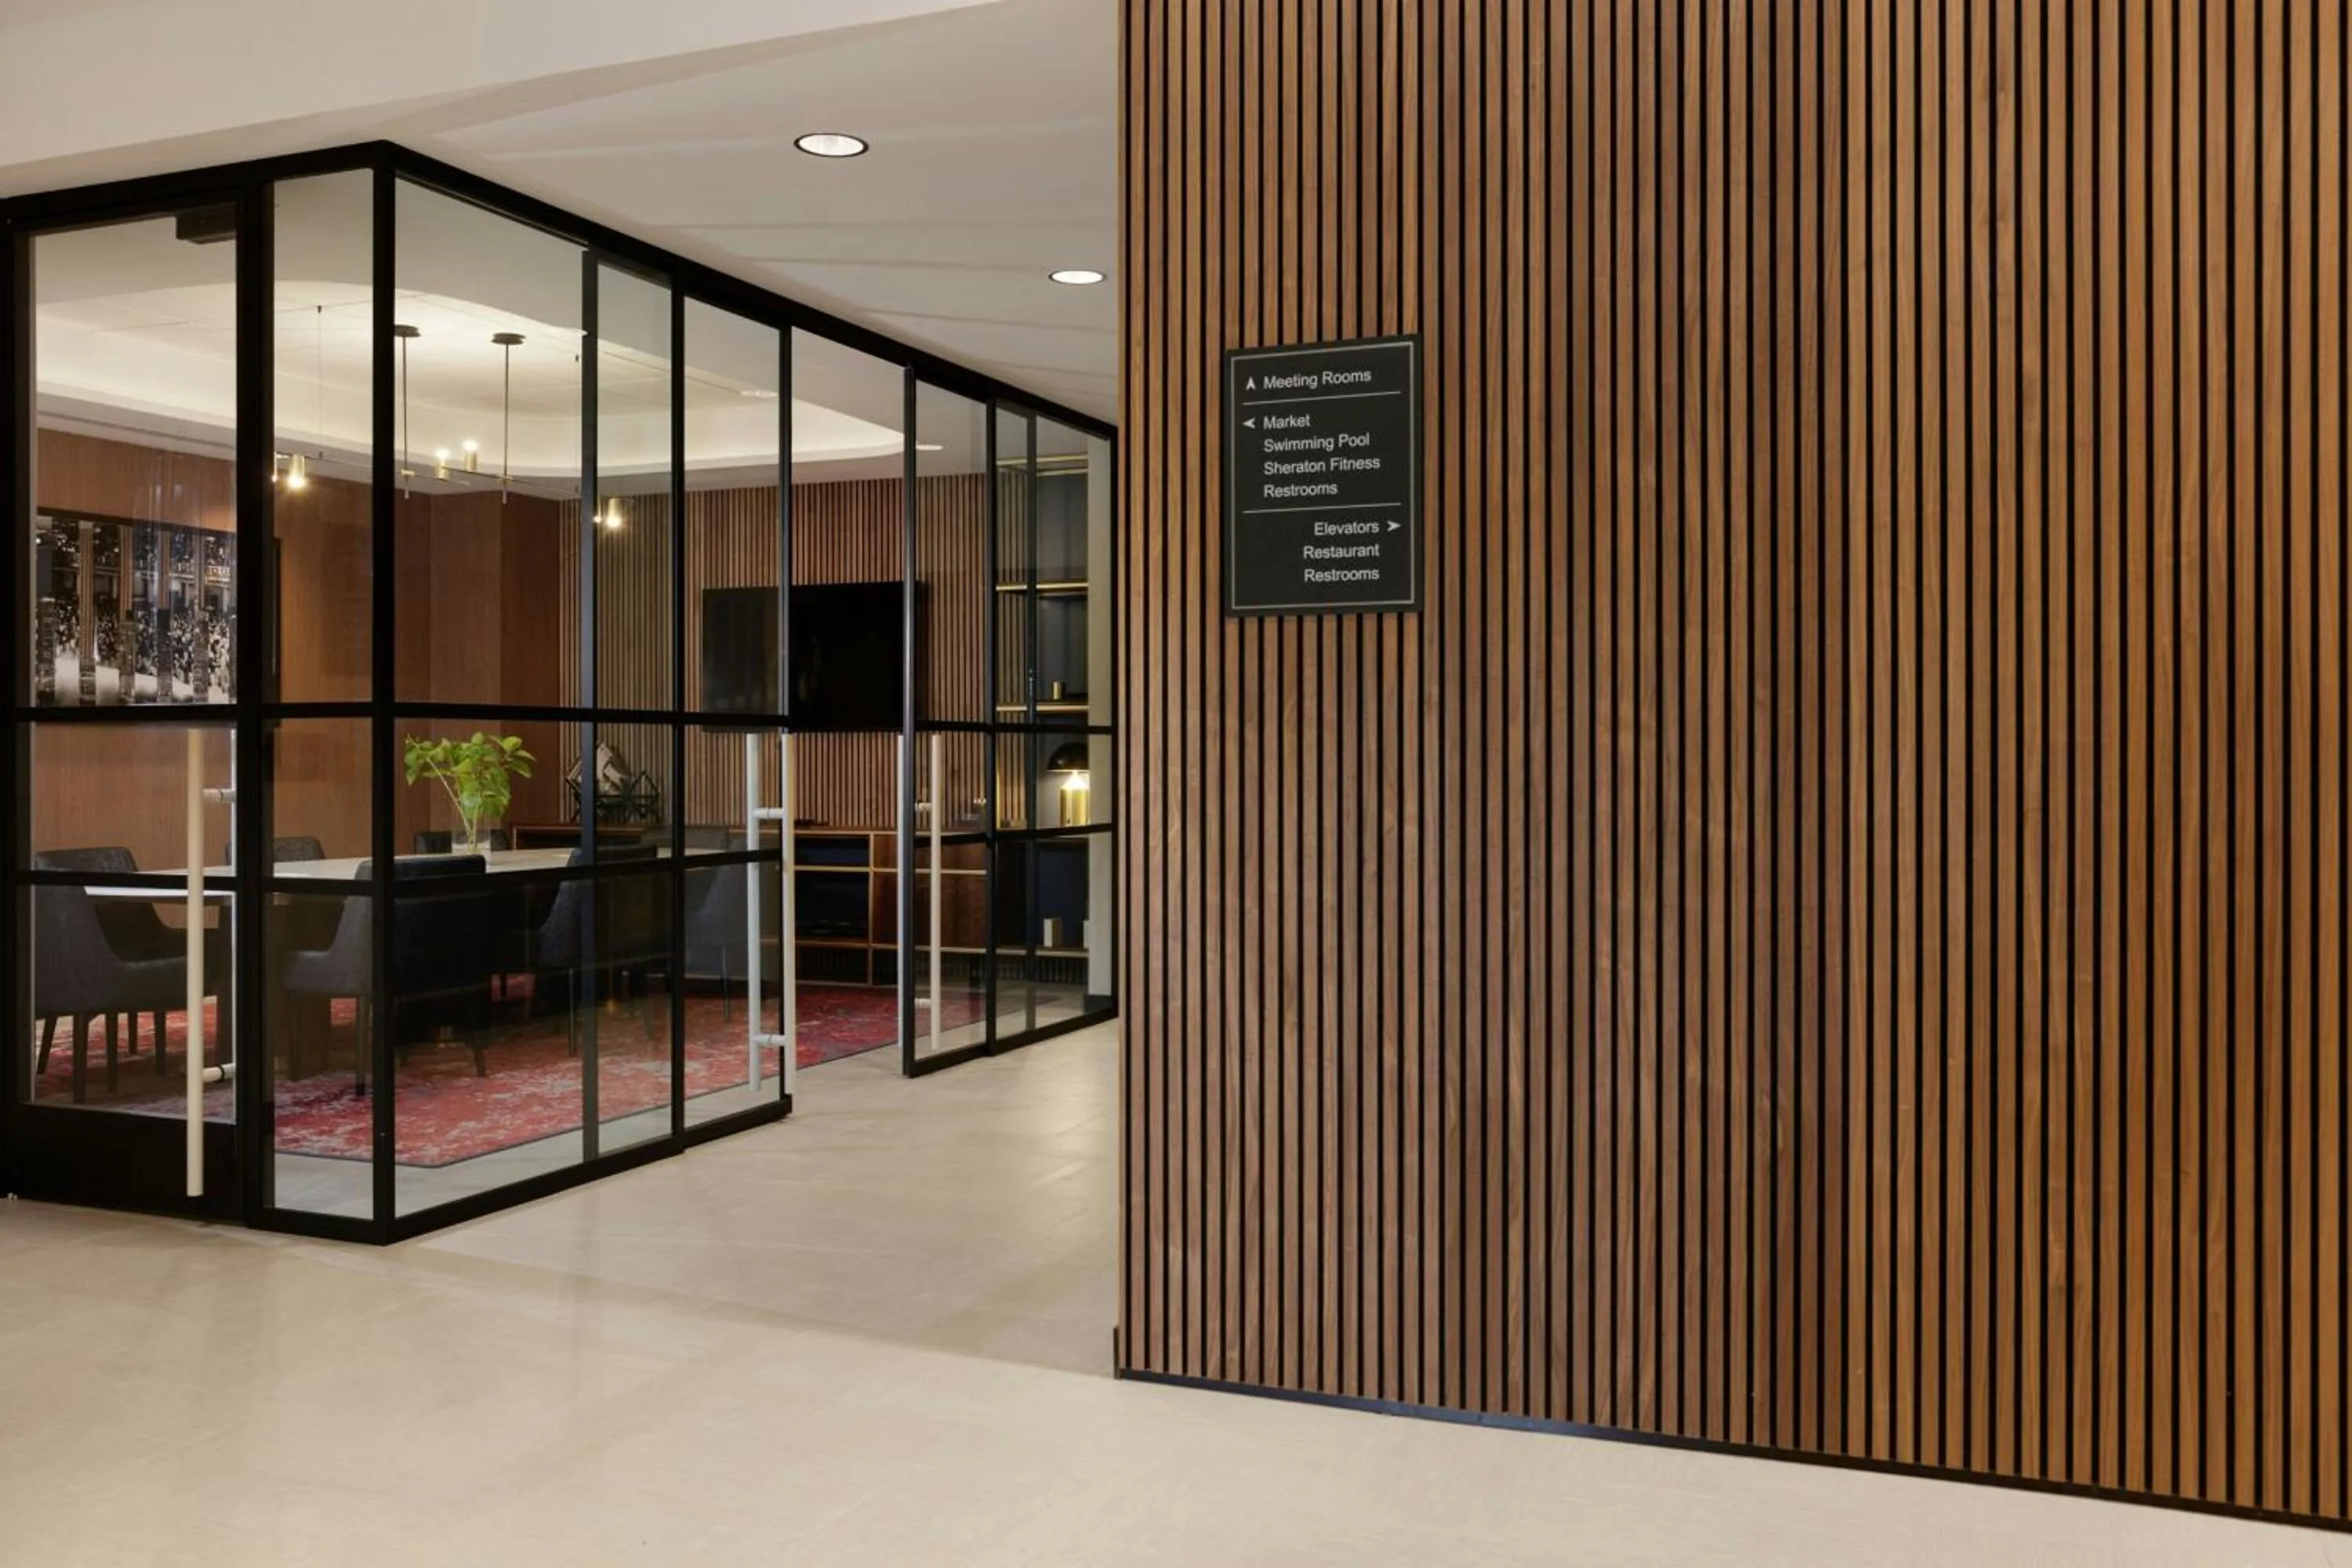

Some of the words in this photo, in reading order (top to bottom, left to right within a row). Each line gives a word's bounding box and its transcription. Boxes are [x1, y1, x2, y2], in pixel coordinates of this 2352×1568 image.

[1263, 374, 1318, 390] Meeting
[1322, 371, 1372, 385] Rooms
[1263, 414, 1311, 430] Market
[1263, 435, 1334, 452] Swimming
[1338, 432, 1370, 448] Pool
[1264, 460, 1326, 475] Sheraton
[1330, 457, 1381, 471] Fitness
[1263, 484, 1338, 498] Restrooms
[1314, 521, 1380, 536] Elevators
[1303, 543, 1380, 559] Restaurant
[1304, 568, 1380, 583] Restrooms
